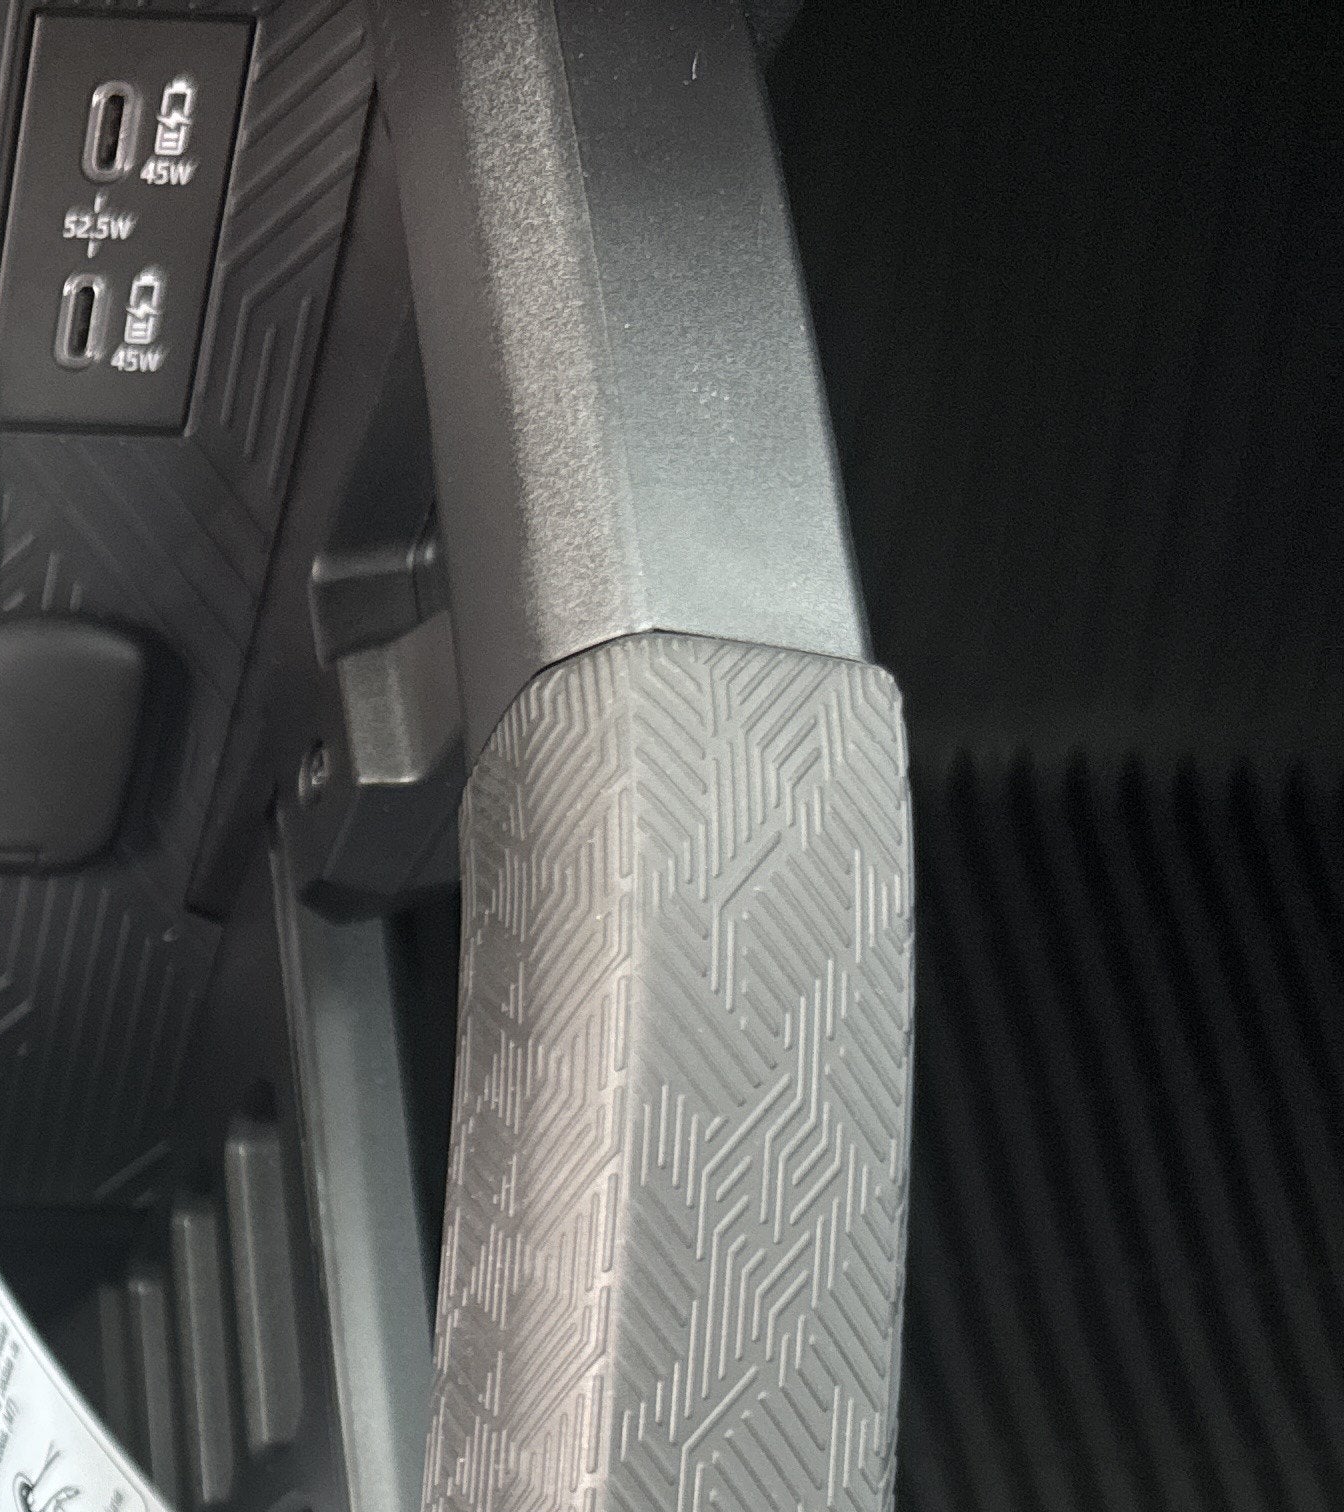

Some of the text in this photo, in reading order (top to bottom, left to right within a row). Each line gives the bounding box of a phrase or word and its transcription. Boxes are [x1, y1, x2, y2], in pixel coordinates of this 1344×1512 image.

[140, 160, 198, 186] 45W
[63, 214, 135, 240] 52.5W
[111, 346, 166, 372] 45W
